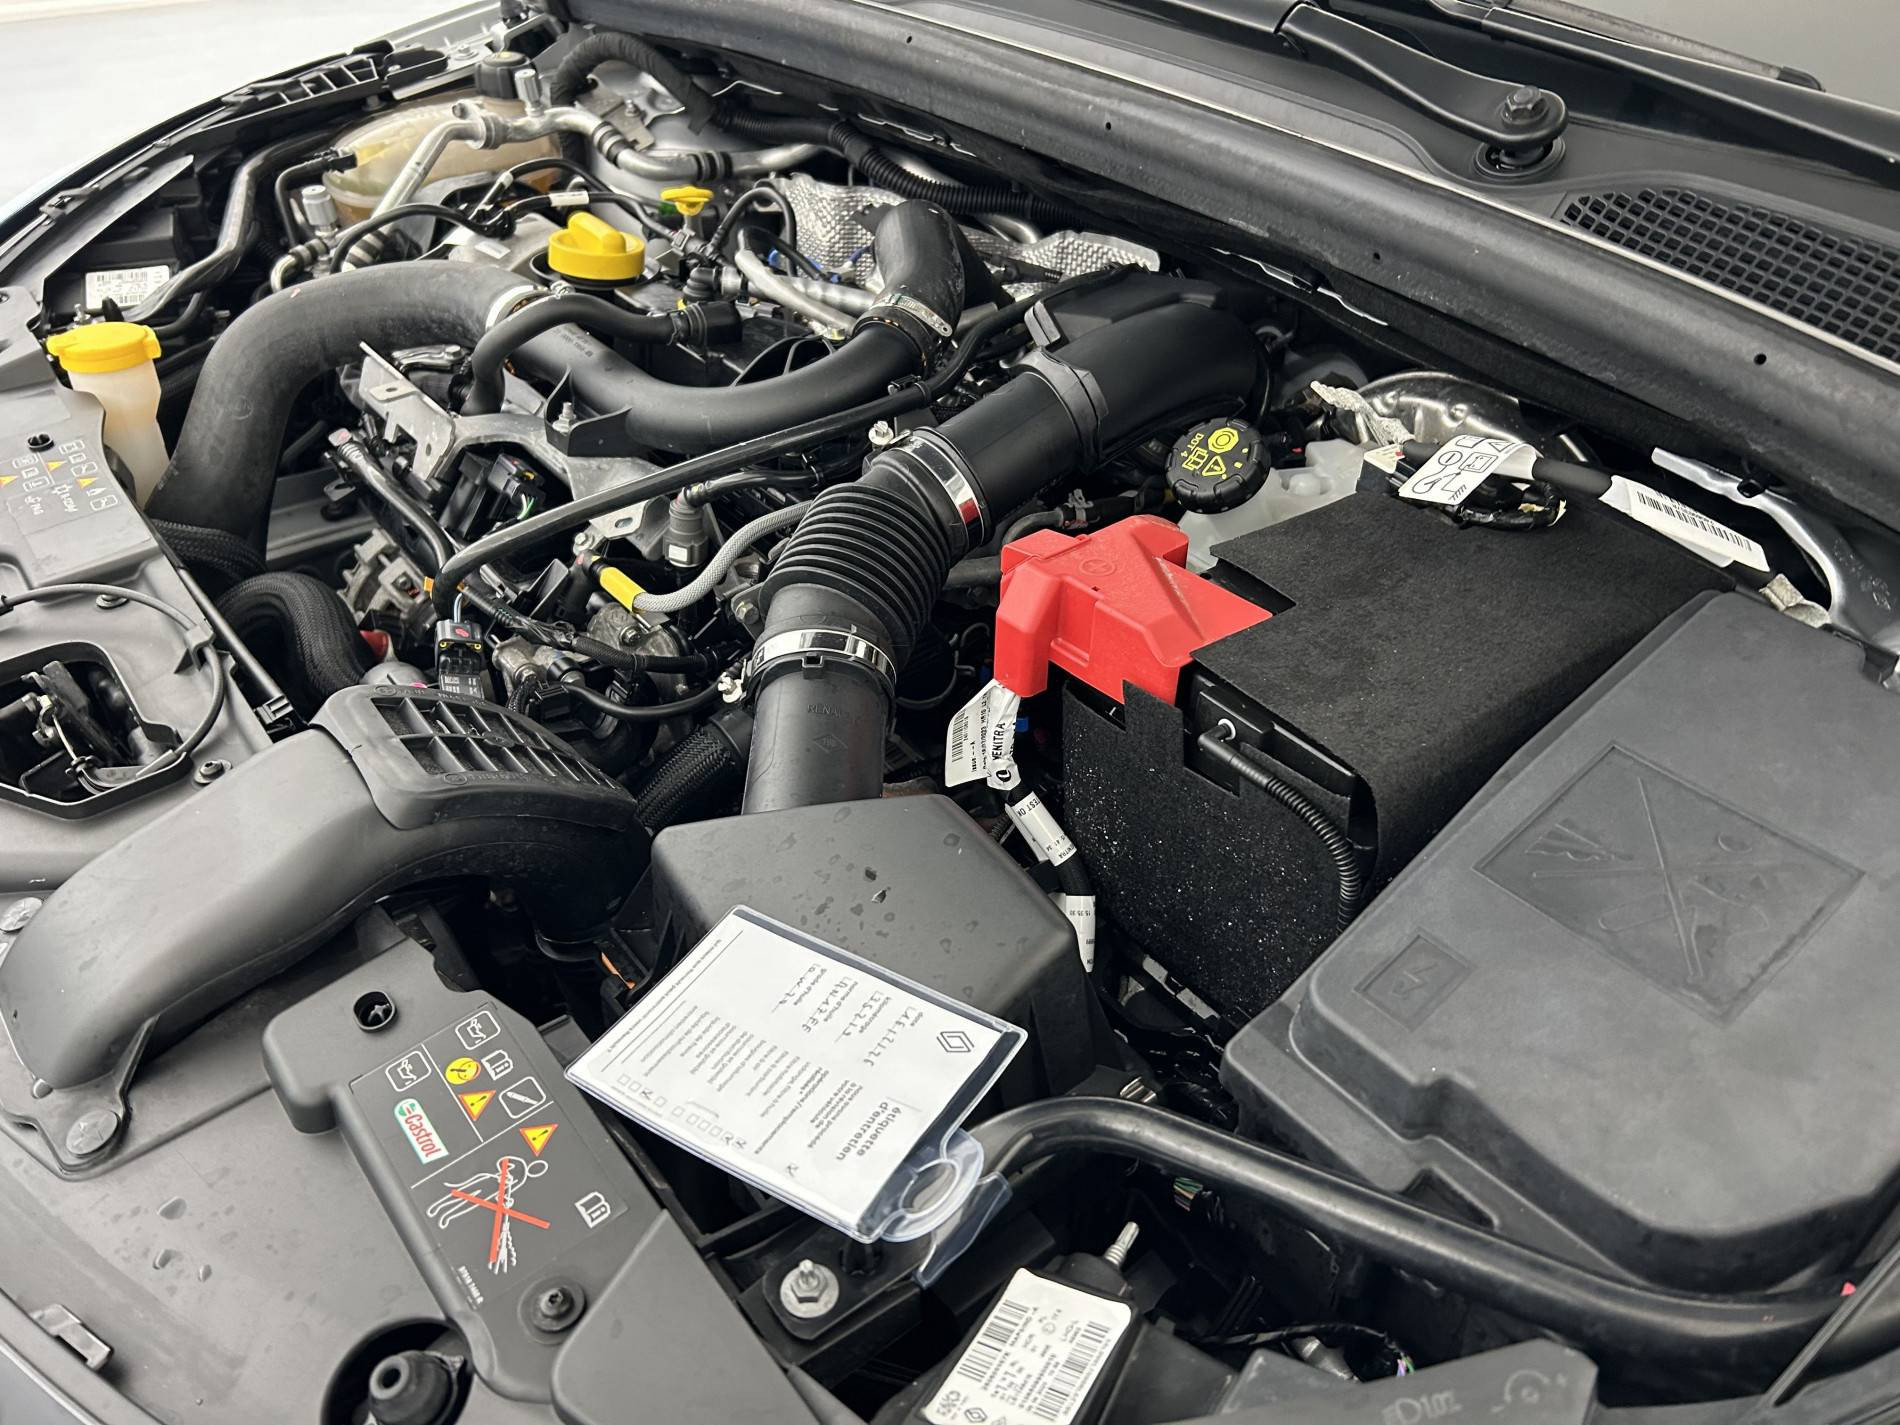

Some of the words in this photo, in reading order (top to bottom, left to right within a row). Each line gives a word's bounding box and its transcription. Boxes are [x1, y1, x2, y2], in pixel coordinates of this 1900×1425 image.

[1180, 450, 1188, 458] 4
[1187, 432, 1204, 451] DOT
[1025, 796, 1040, 811] TEST
[404, 1111, 441, 1158] Castrol
[835, 1100, 890, 1163] d'entretien
[854, 1104, 903, 1158] étiquette
